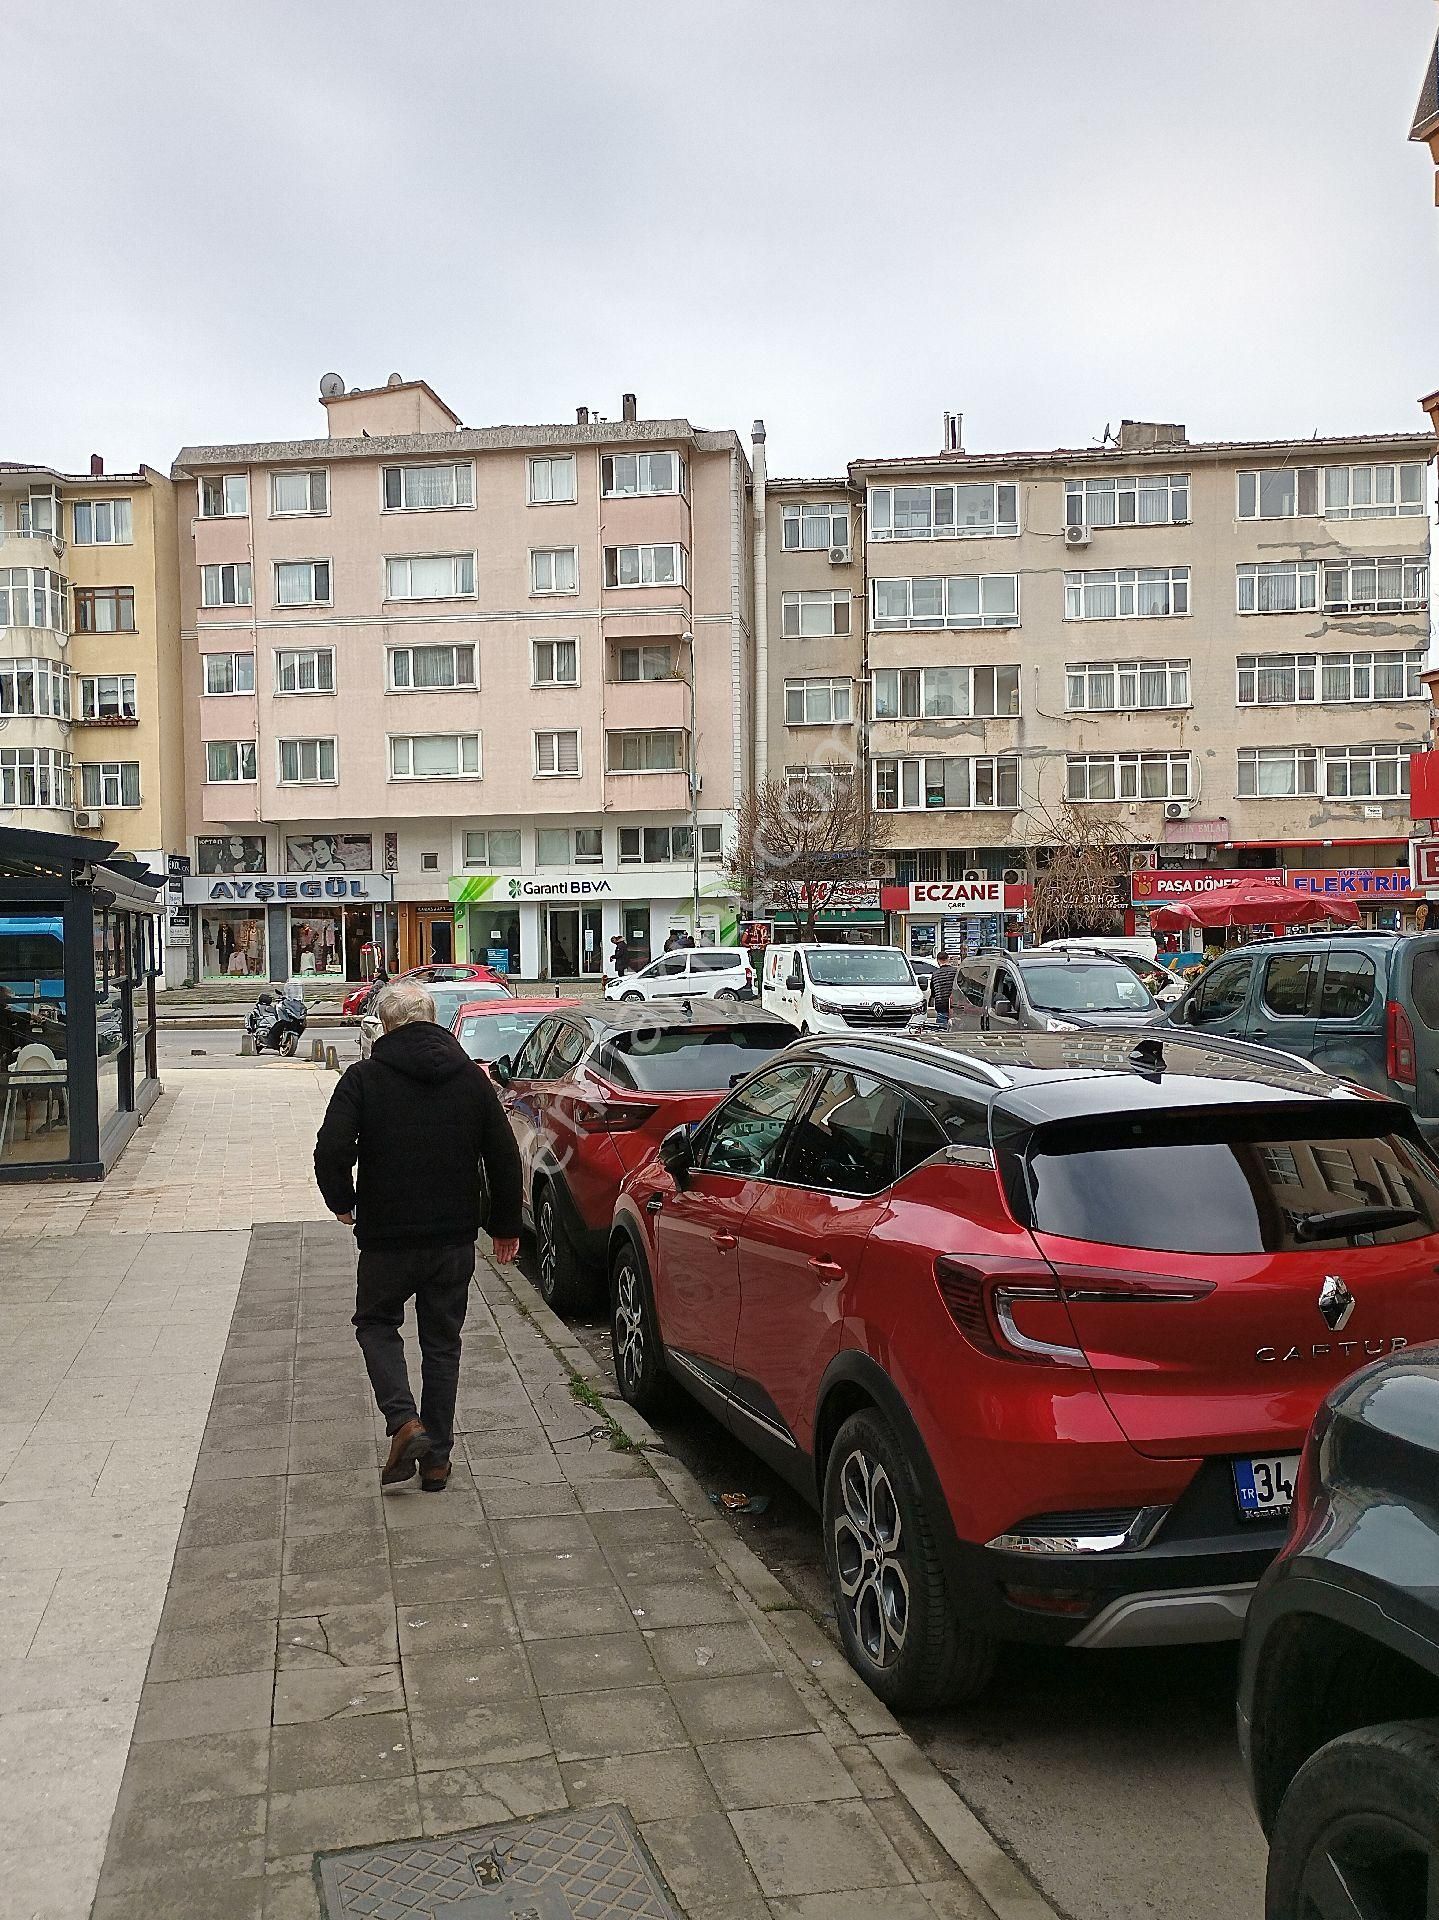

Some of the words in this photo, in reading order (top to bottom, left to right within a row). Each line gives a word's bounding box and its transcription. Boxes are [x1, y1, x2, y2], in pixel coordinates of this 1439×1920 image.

[209, 877, 368, 902] AYŞEGÜL
[523, 881, 567, 894] Garanti
[570, 880, 611, 893] BBVA
[914, 884, 999, 902] ECZANE
[1157, 880, 1193, 895] PAŞA
[1256, 1337, 1408, 1362] CAPTUR
[1254, 1462, 1293, 1502] 34
[1241, 1489, 1255, 1500] TR
